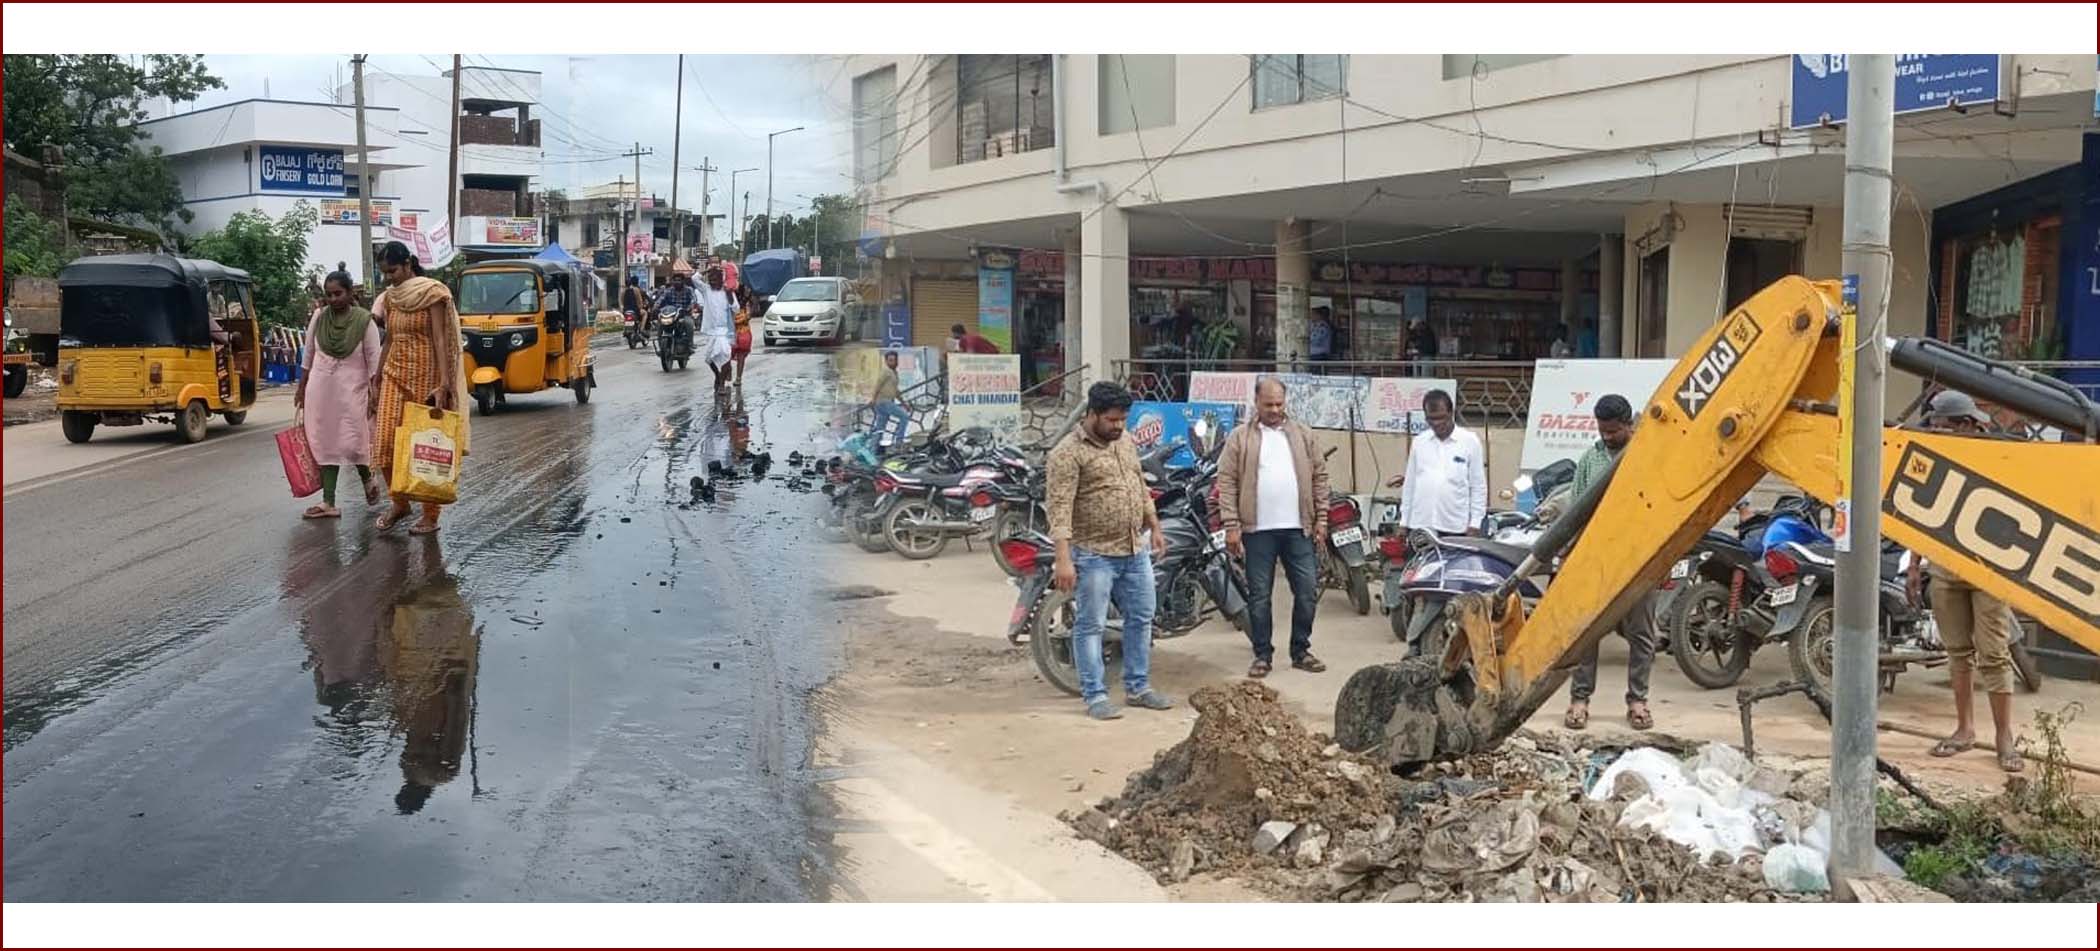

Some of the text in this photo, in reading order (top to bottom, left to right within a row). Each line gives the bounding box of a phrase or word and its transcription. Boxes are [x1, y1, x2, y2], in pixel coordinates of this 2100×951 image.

[275, 154, 301, 168] BAJAJ
[275, 169, 302, 182] FINSERV
[307, 173, 344, 187] GOLD LOAN
[952, 394, 975, 405] CHAT
[1539, 413, 1598, 431] DAZZL
[1893, 469, 2098, 617] JCB
